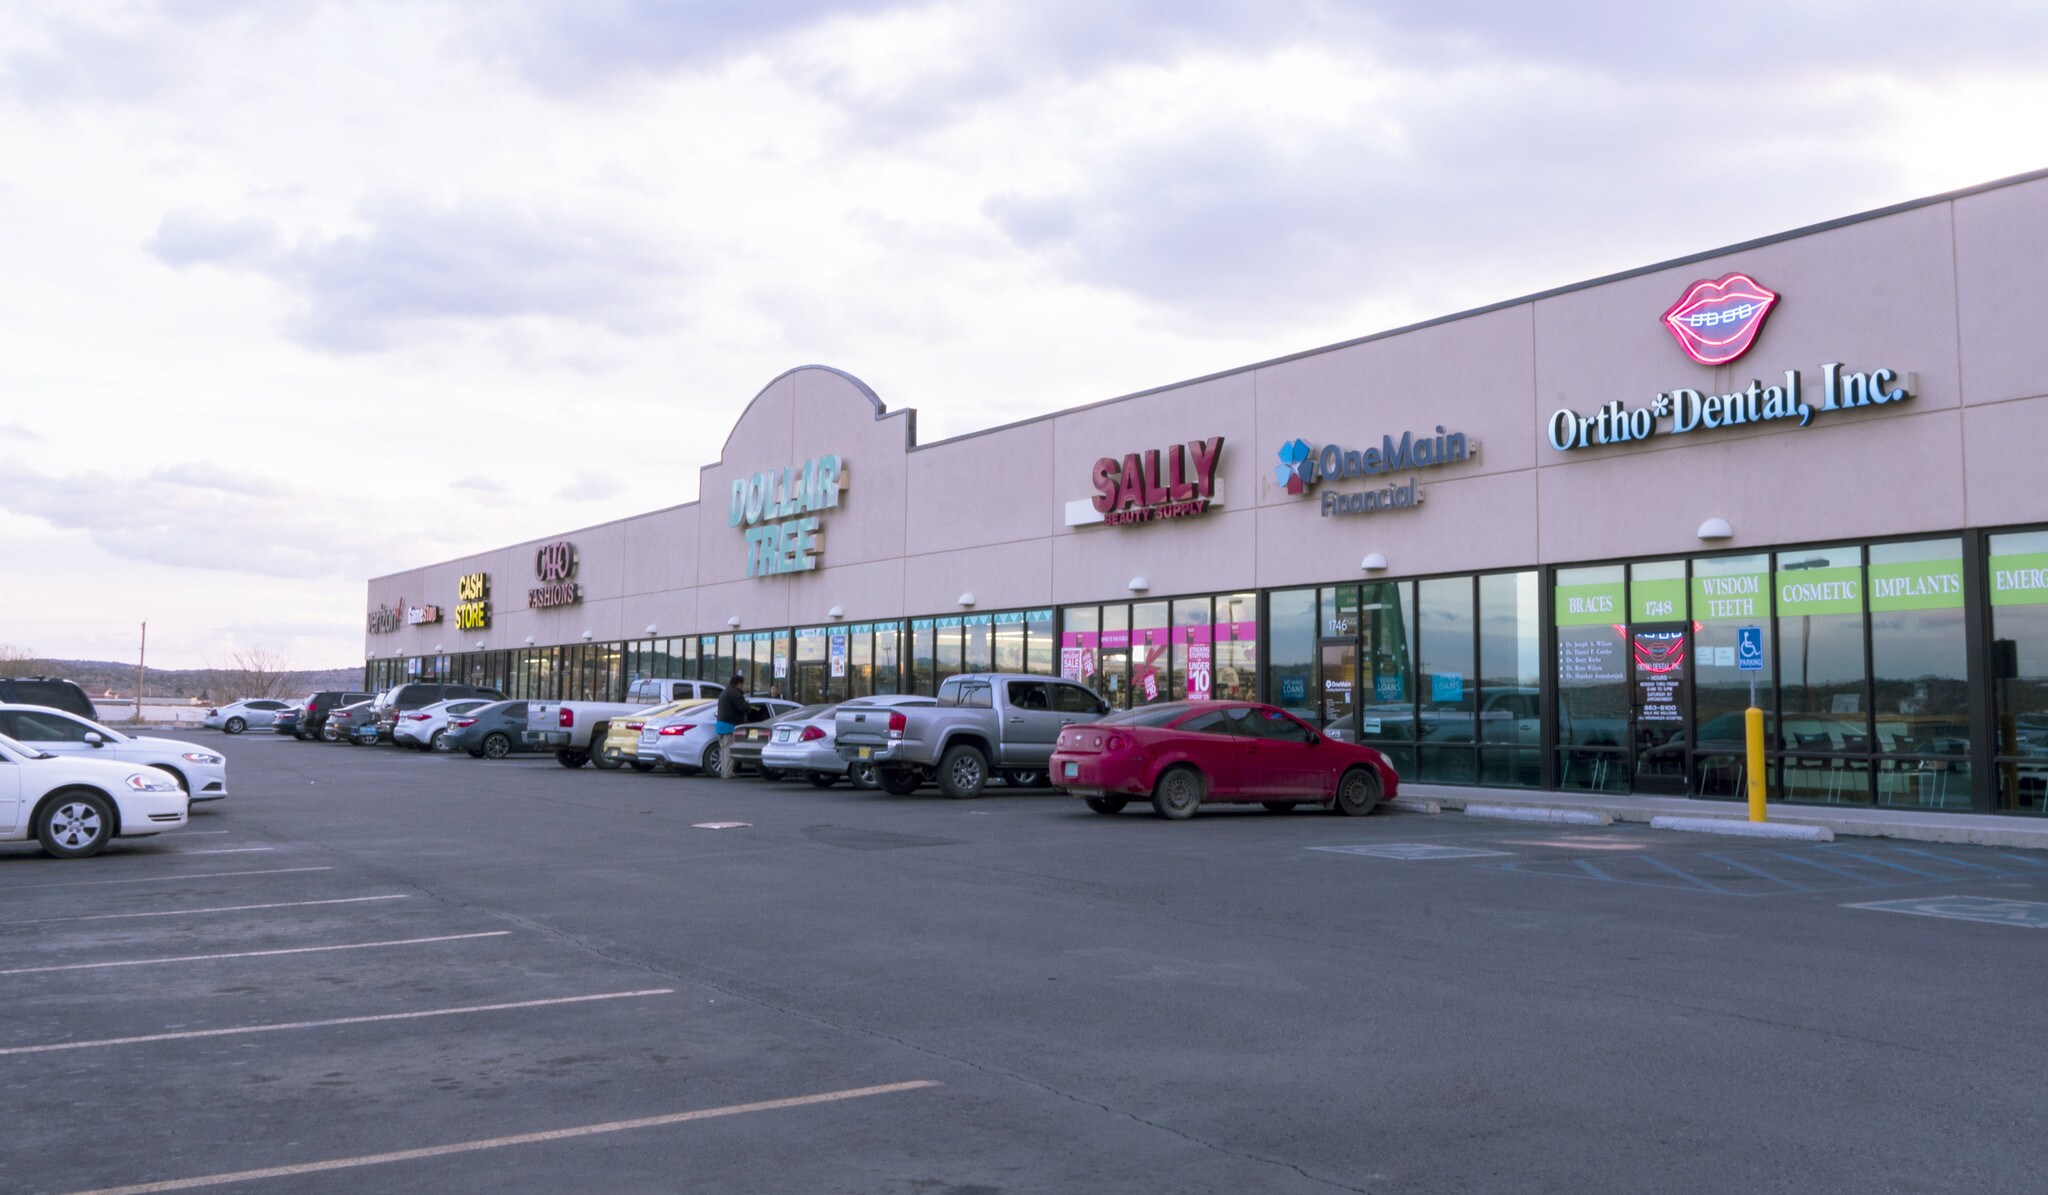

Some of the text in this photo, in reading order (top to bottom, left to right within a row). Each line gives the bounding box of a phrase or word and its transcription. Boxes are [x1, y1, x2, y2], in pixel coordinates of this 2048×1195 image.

[1819, 362, 1904, 412] Inc.
[1320, 425, 1468, 481] OneMain
[1092, 436, 1225, 513] SALLY
[728, 454, 842, 528] DOLLAR
[1321, 477, 1417, 517] Financial
[1104, 501, 1207, 526] BEAUTY SUPPLY
[745, 517, 819, 577] TREE
[535, 542, 572, 581] CATO
[459, 573, 485, 600] CASH
[528, 583, 575, 608] FASHIONS
[1703, 576, 1759, 596] WISDOM
[1782, 580, 1857, 603] COSMETIC
[1874, 573, 1960, 598] IMPLANTS
[408, 605, 437, 624] GameStop
[455, 602, 486, 630] STORE
[1569, 596, 1613, 614] BRACES
[1645, 601, 1673, 616] 1748
[1708, 598, 1754, 617] TEETH
[368, 603, 399, 635] verizon
[1329, 619, 1348, 632] 1746
[1063, 659, 1079, 668] SALE
[1189, 661, 1210, 670] UNDER
[1189, 669, 1210, 691] $10
[1283, 685, 1304, 694] LOANS
[1377, 683, 1401, 691] LOANS
